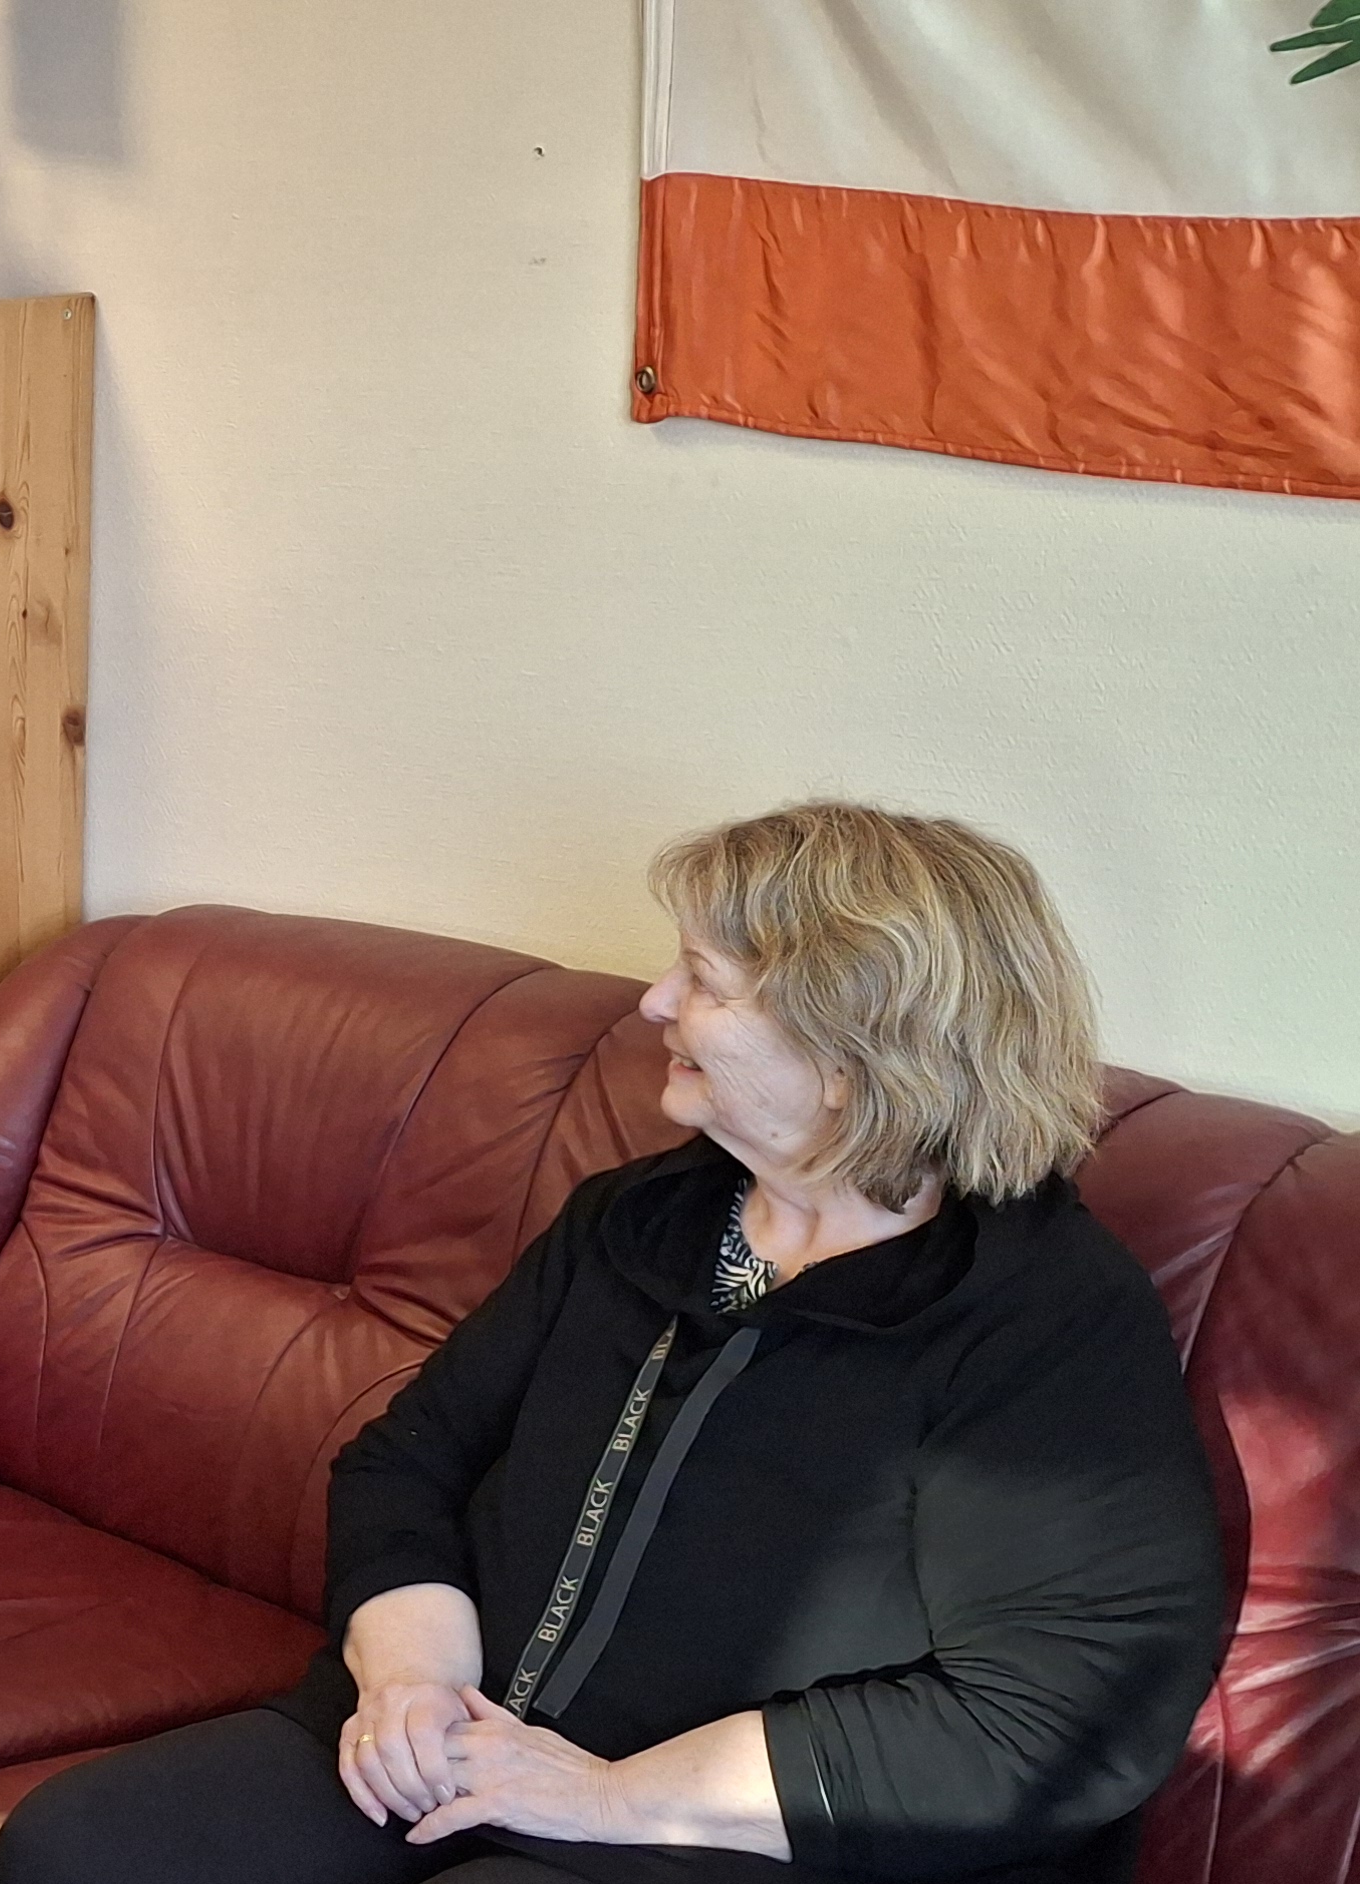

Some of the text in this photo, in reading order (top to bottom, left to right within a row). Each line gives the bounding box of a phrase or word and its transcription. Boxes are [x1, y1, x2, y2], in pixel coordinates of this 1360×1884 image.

[612, 1387, 651, 1452] BLACK
[577, 1477, 614, 1547] BLACK
[537, 1575, 580, 1643] BLACK
[508, 1667, 538, 1717] ACK
